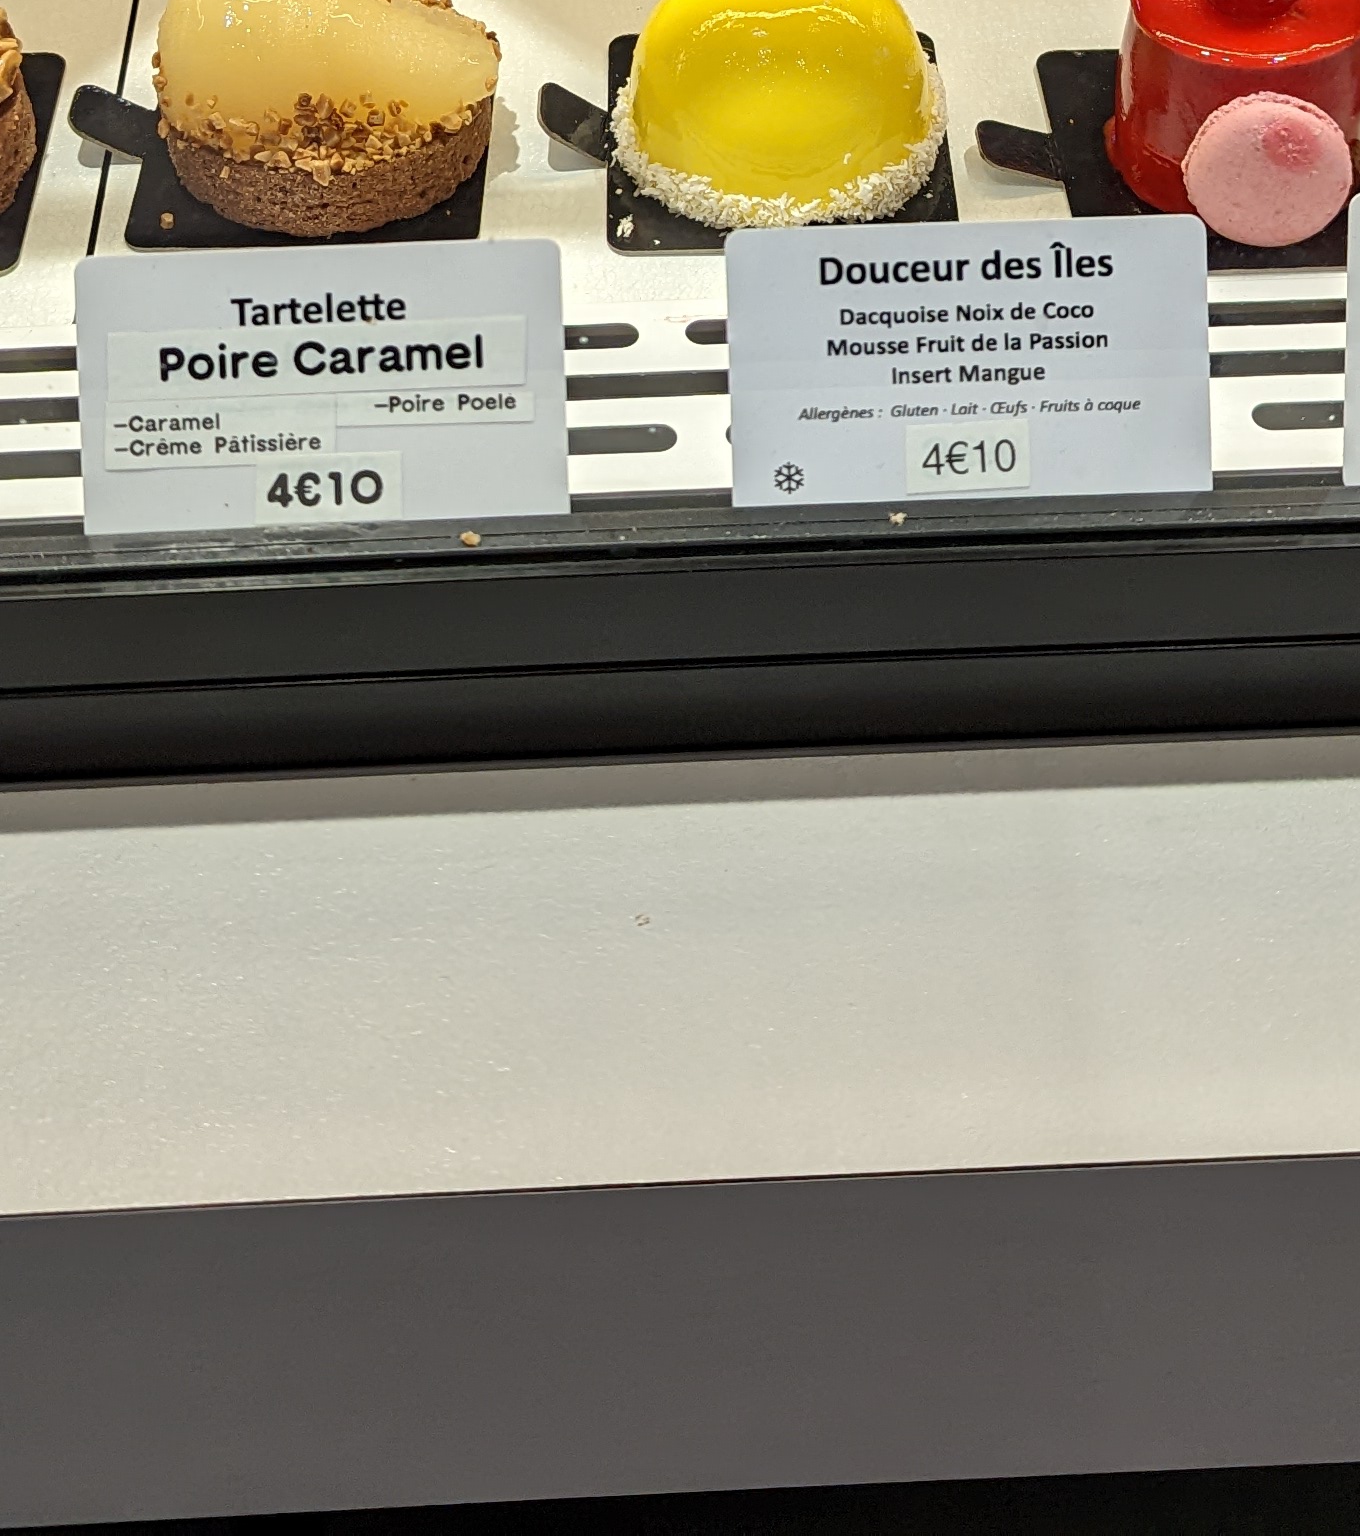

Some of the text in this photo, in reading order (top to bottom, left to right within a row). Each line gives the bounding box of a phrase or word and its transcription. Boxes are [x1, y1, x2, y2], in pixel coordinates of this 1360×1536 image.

[820, 242, 1113, 285] Douceur des Îles
[231, 293, 405, 326] Tartelette
[840, 302, 1094, 328] Dacquoise Noix de Coco
[160, 334, 483, 382] Poire Caramel
[828, 332, 1107, 356] Mousse Fruit de la Passion
[892, 365, 1045, 385] Insert Mangue
[798, 407, 873, 422] Allergènes
[891, 405, 938, 417] Gluten
[951, 403, 978, 415] Lait
[1040, 400, 1080, 412] Fruits
[1084, 399, 1093, 411] à
[1098, 400, 1141, 413] coque
[215, 433, 321, 453] Pâtissière
[922, 439, 1016, 475] 4€10
[267, 470, 383, 507] 4€10
